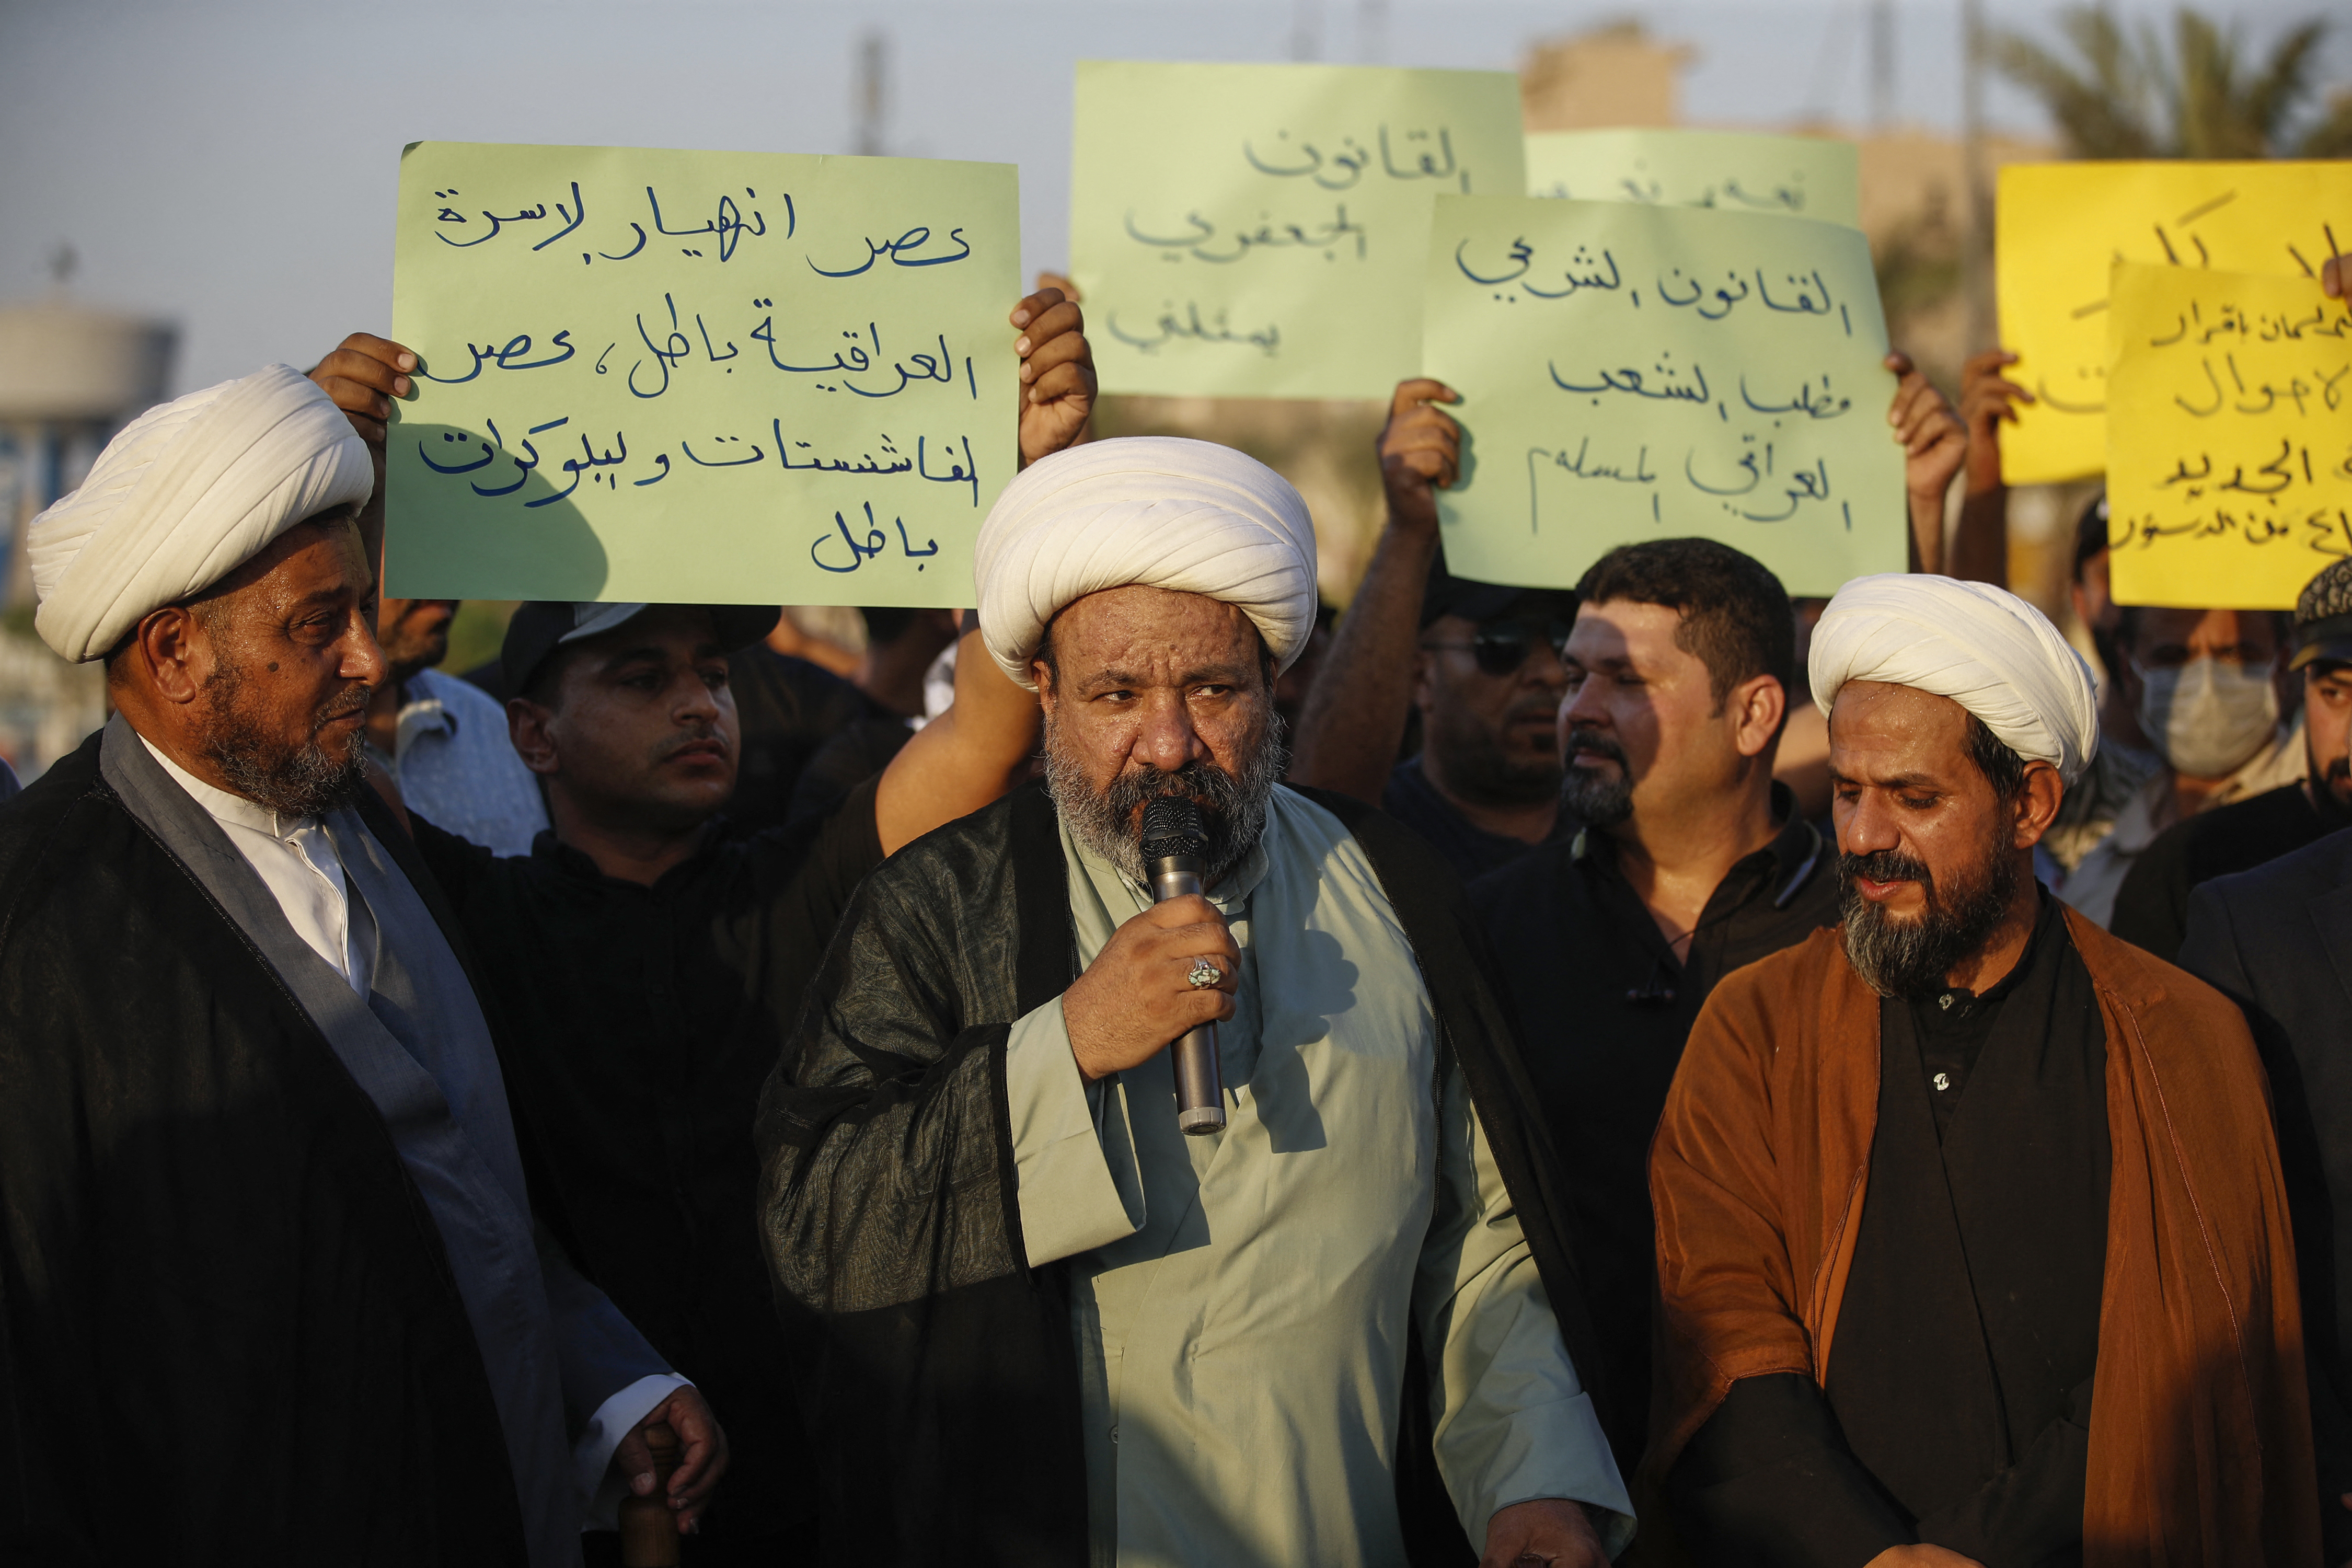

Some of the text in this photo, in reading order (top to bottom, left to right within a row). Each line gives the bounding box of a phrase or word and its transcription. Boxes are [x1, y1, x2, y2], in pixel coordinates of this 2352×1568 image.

[1243, 124, 1471, 194] القانون
[597, 186, 795, 263] انهيار
[805, 227, 971, 278] عصر
[1124, 203, 1367, 263] الجعفري
[1455, 235, 1852, 337] القانون الشرعي
[418, 329, 575, 385] عصر
[750, 298, 977, 401] العراقية
[1548, 351, 1852, 429] مطلب الشعب
[1527, 433, 1852, 534] العراقي المسلم
[2157, 437, 2314, 509] الجديد
[811, 500, 939, 573] باطل
